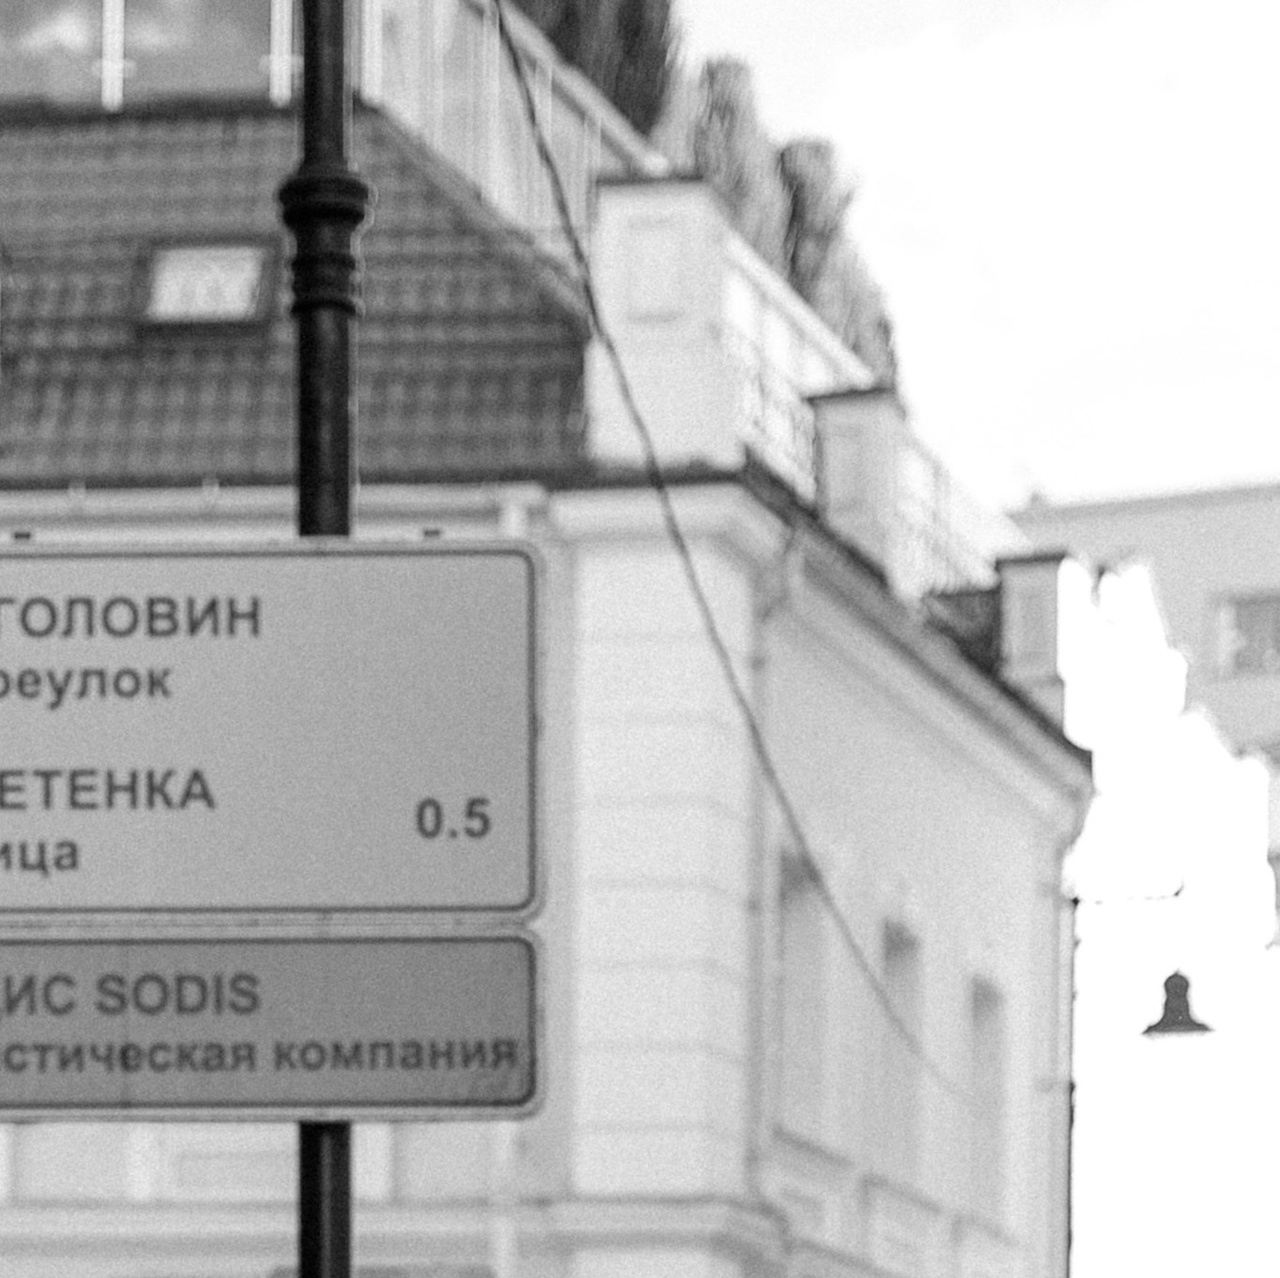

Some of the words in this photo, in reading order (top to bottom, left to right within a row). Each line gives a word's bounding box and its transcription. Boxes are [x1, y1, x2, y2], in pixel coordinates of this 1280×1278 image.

[415, 796, 492, 840] 0.5
[96, 972, 260, 1016] SODIS
[274, 1038, 518, 1071] компания
